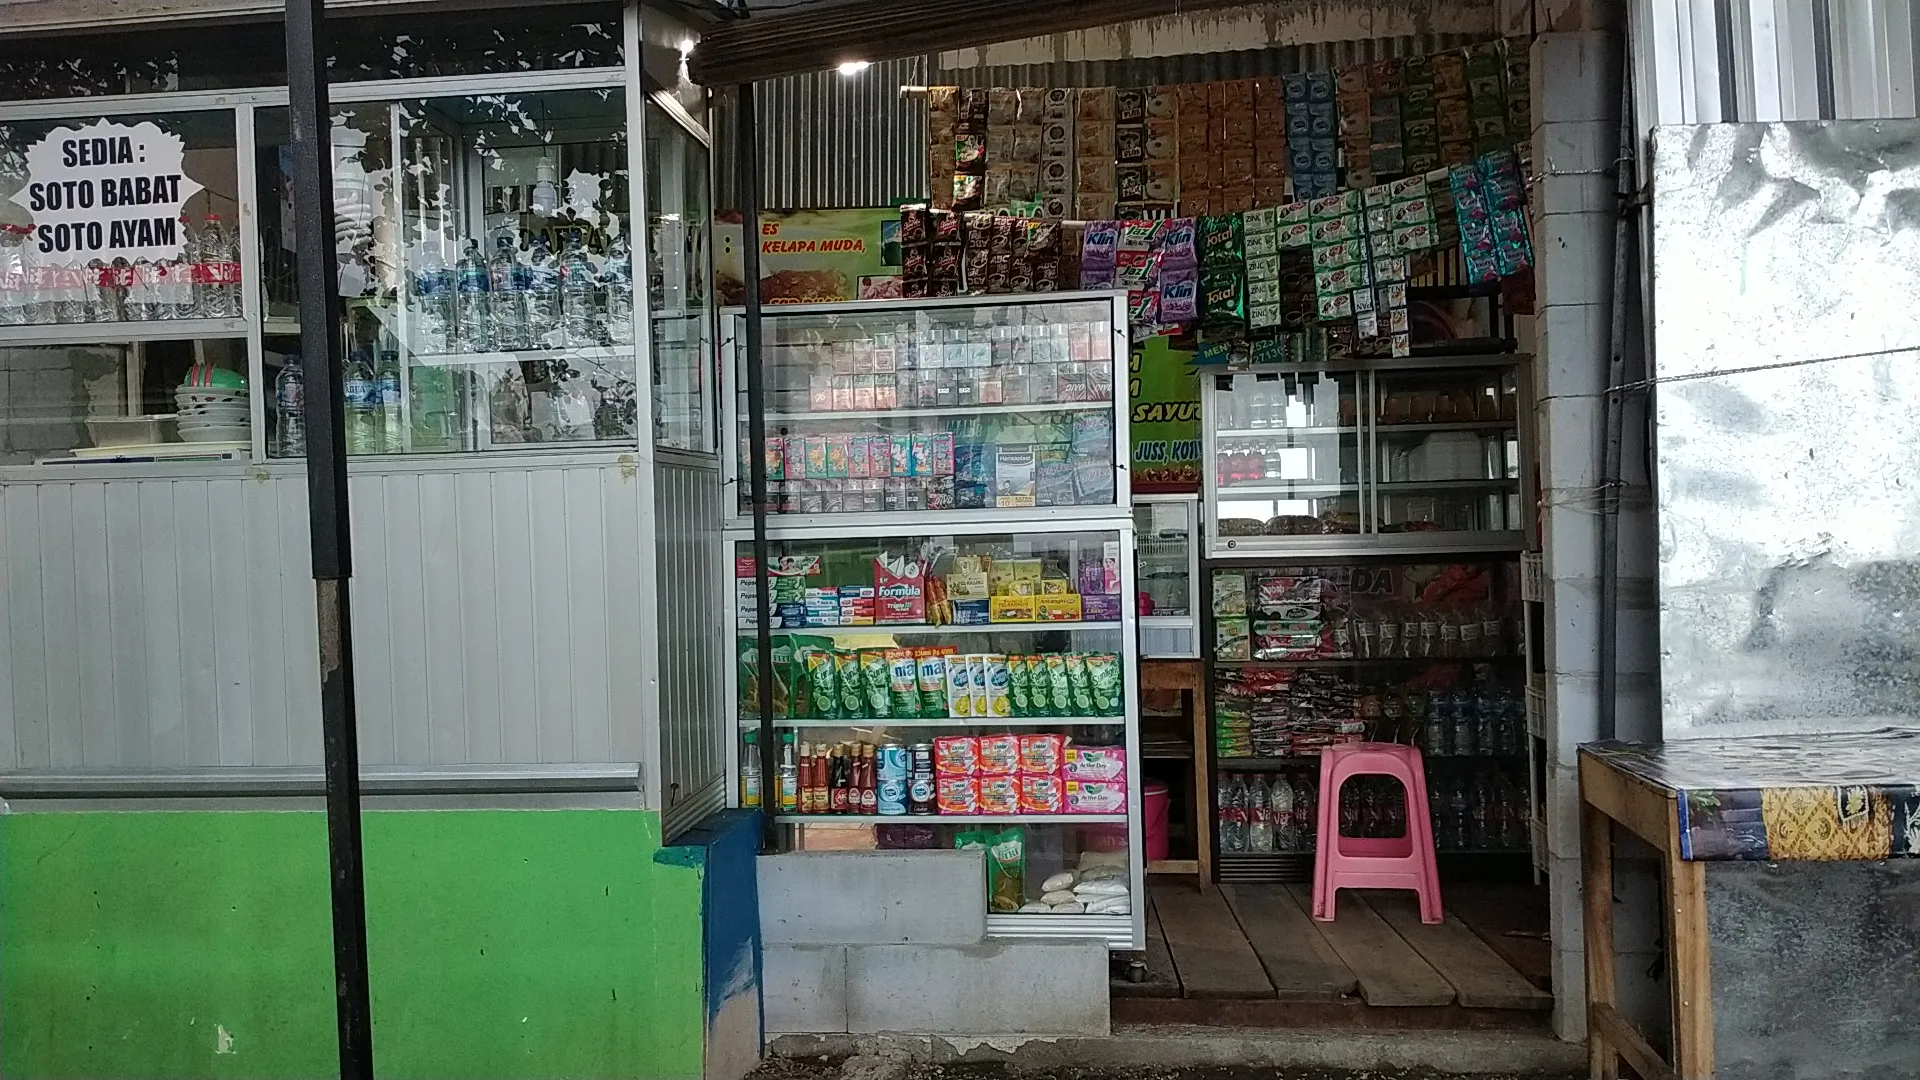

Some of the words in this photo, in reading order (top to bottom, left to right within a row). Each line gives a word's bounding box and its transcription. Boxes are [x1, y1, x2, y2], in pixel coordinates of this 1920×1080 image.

[62, 136, 134, 167] SEDIA
[29, 179, 94, 211] SOTO
[101, 175, 181, 207] BABAT
[38, 221, 103, 253] SOTO
[109, 217, 176, 248] AYAM
[762, 223, 779, 235] ES
[1087, 232, 1114, 245] Klin
[1167, 232, 1191, 246] Klin
[1207, 226, 1233, 248] Total
[1247, 238, 1262, 247] ZINC
[762, 240, 816, 254] KELAPA
[820, 239, 866, 254] MUDA,
[1249, 261, 1264, 271] ZINC
[1164, 285, 1192, 299] Klin
[1206, 283, 1235, 305] Total
[1250, 285, 1265, 295] ZINC
[1252, 309, 1267, 318] ZINC
[878, 585, 921, 597] Formula
[1092, 665, 1118, 686] Sunlight
[1273, 813, 1291, 826] Vit
